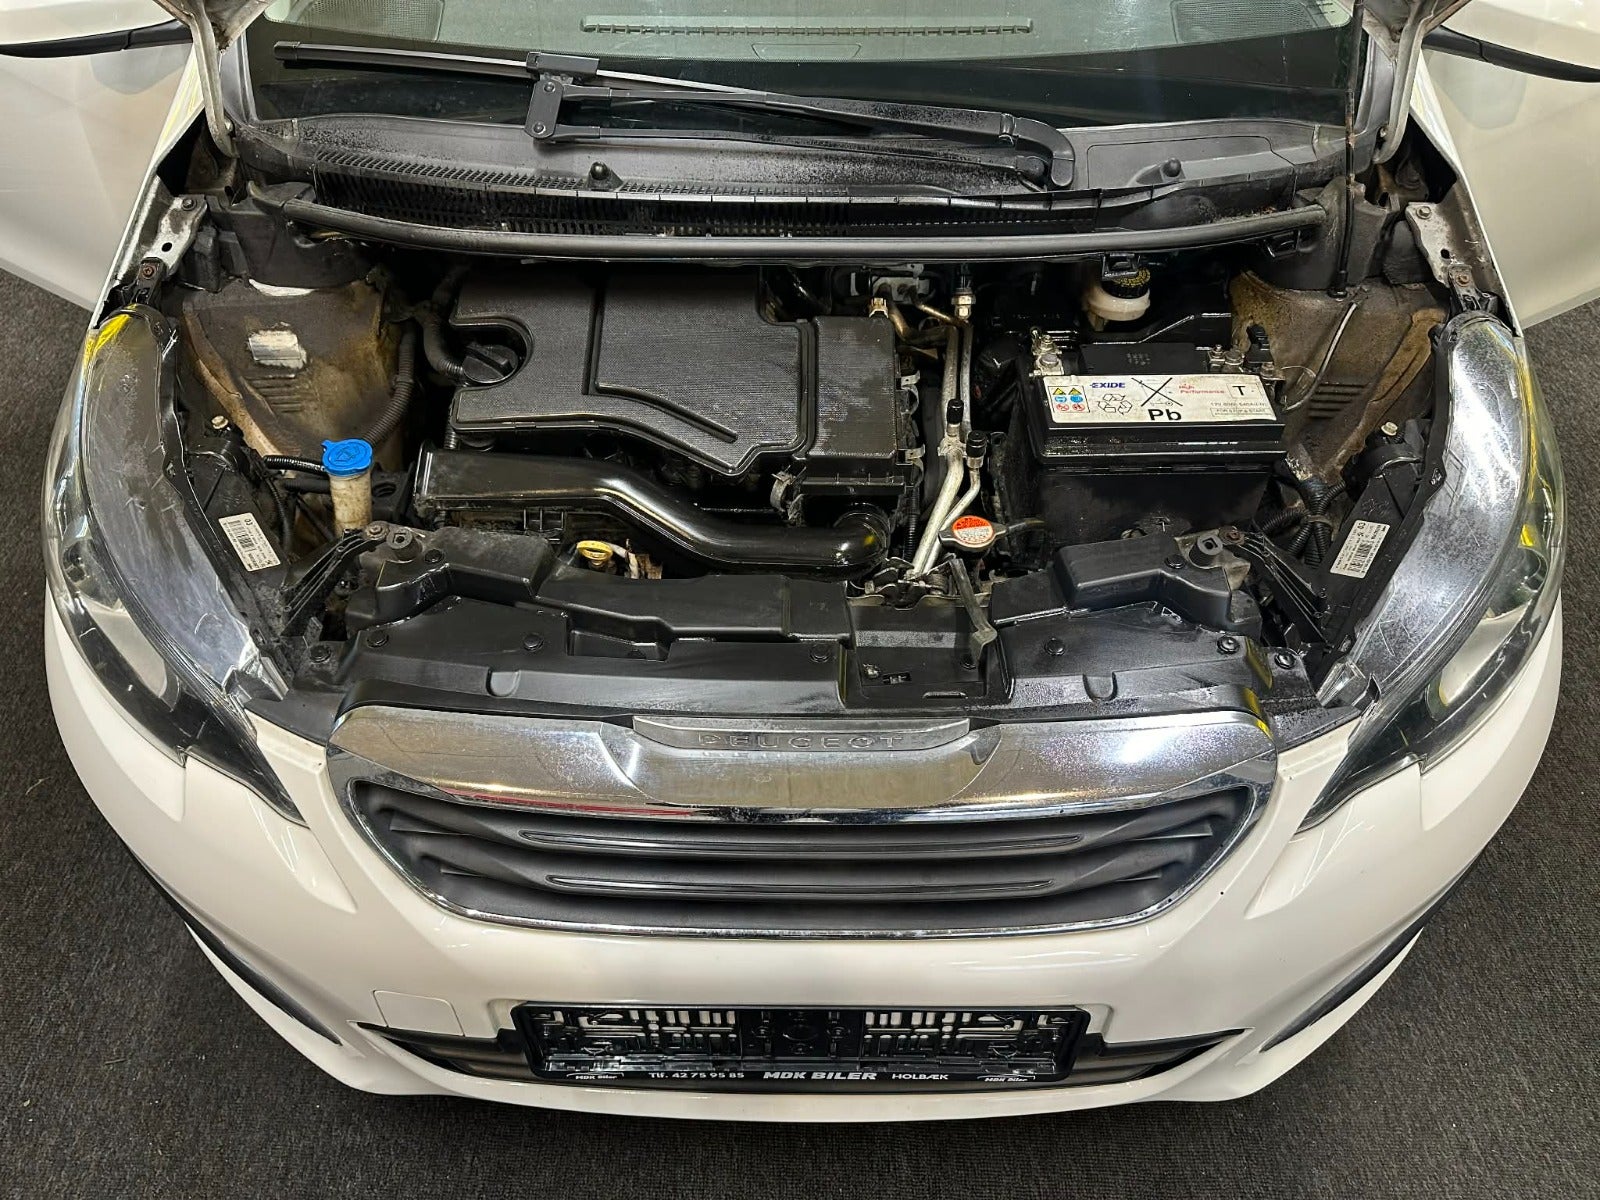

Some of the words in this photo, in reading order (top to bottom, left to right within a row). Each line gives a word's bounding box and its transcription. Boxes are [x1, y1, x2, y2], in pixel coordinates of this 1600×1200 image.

[1231, 385, 1246, 396] T
[1148, 408, 1182, 421] Pb
[698, 734, 902, 749] PEUGEOT
[763, 1071, 807, 1079] MDK
[811, 1072, 877, 1080] BILER
